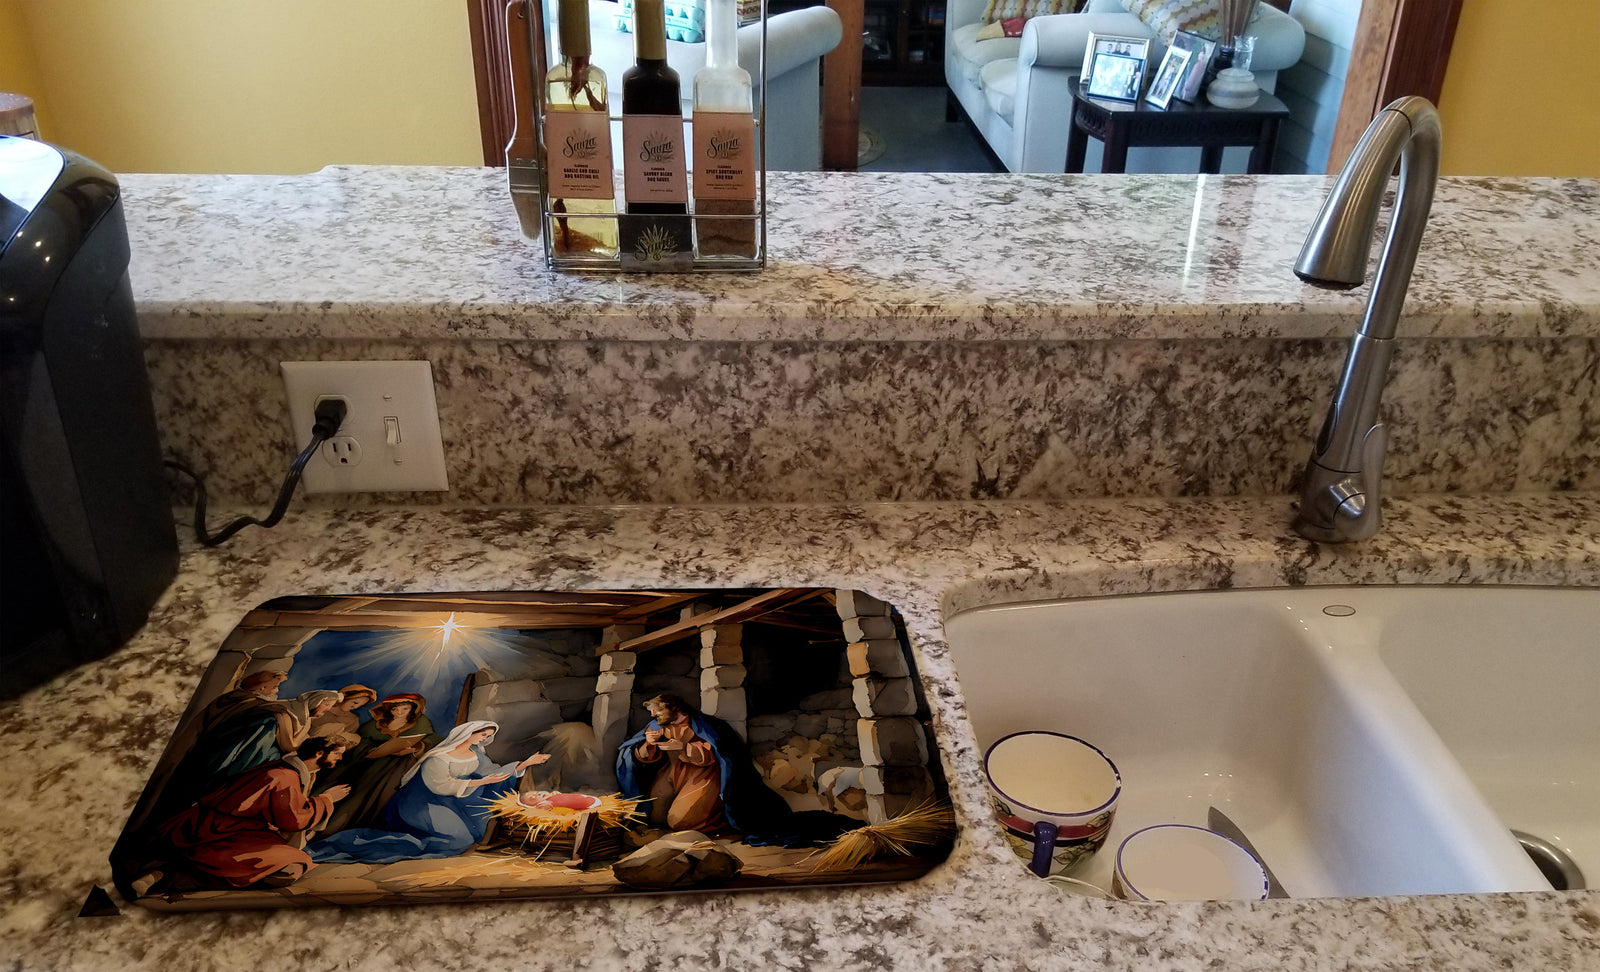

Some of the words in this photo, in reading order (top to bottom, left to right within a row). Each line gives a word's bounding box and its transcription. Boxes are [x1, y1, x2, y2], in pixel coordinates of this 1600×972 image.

[563, 136, 598, 158] Sauza
[640, 140, 673, 161] Sauza
[707, 137, 740, 158] Sauza
